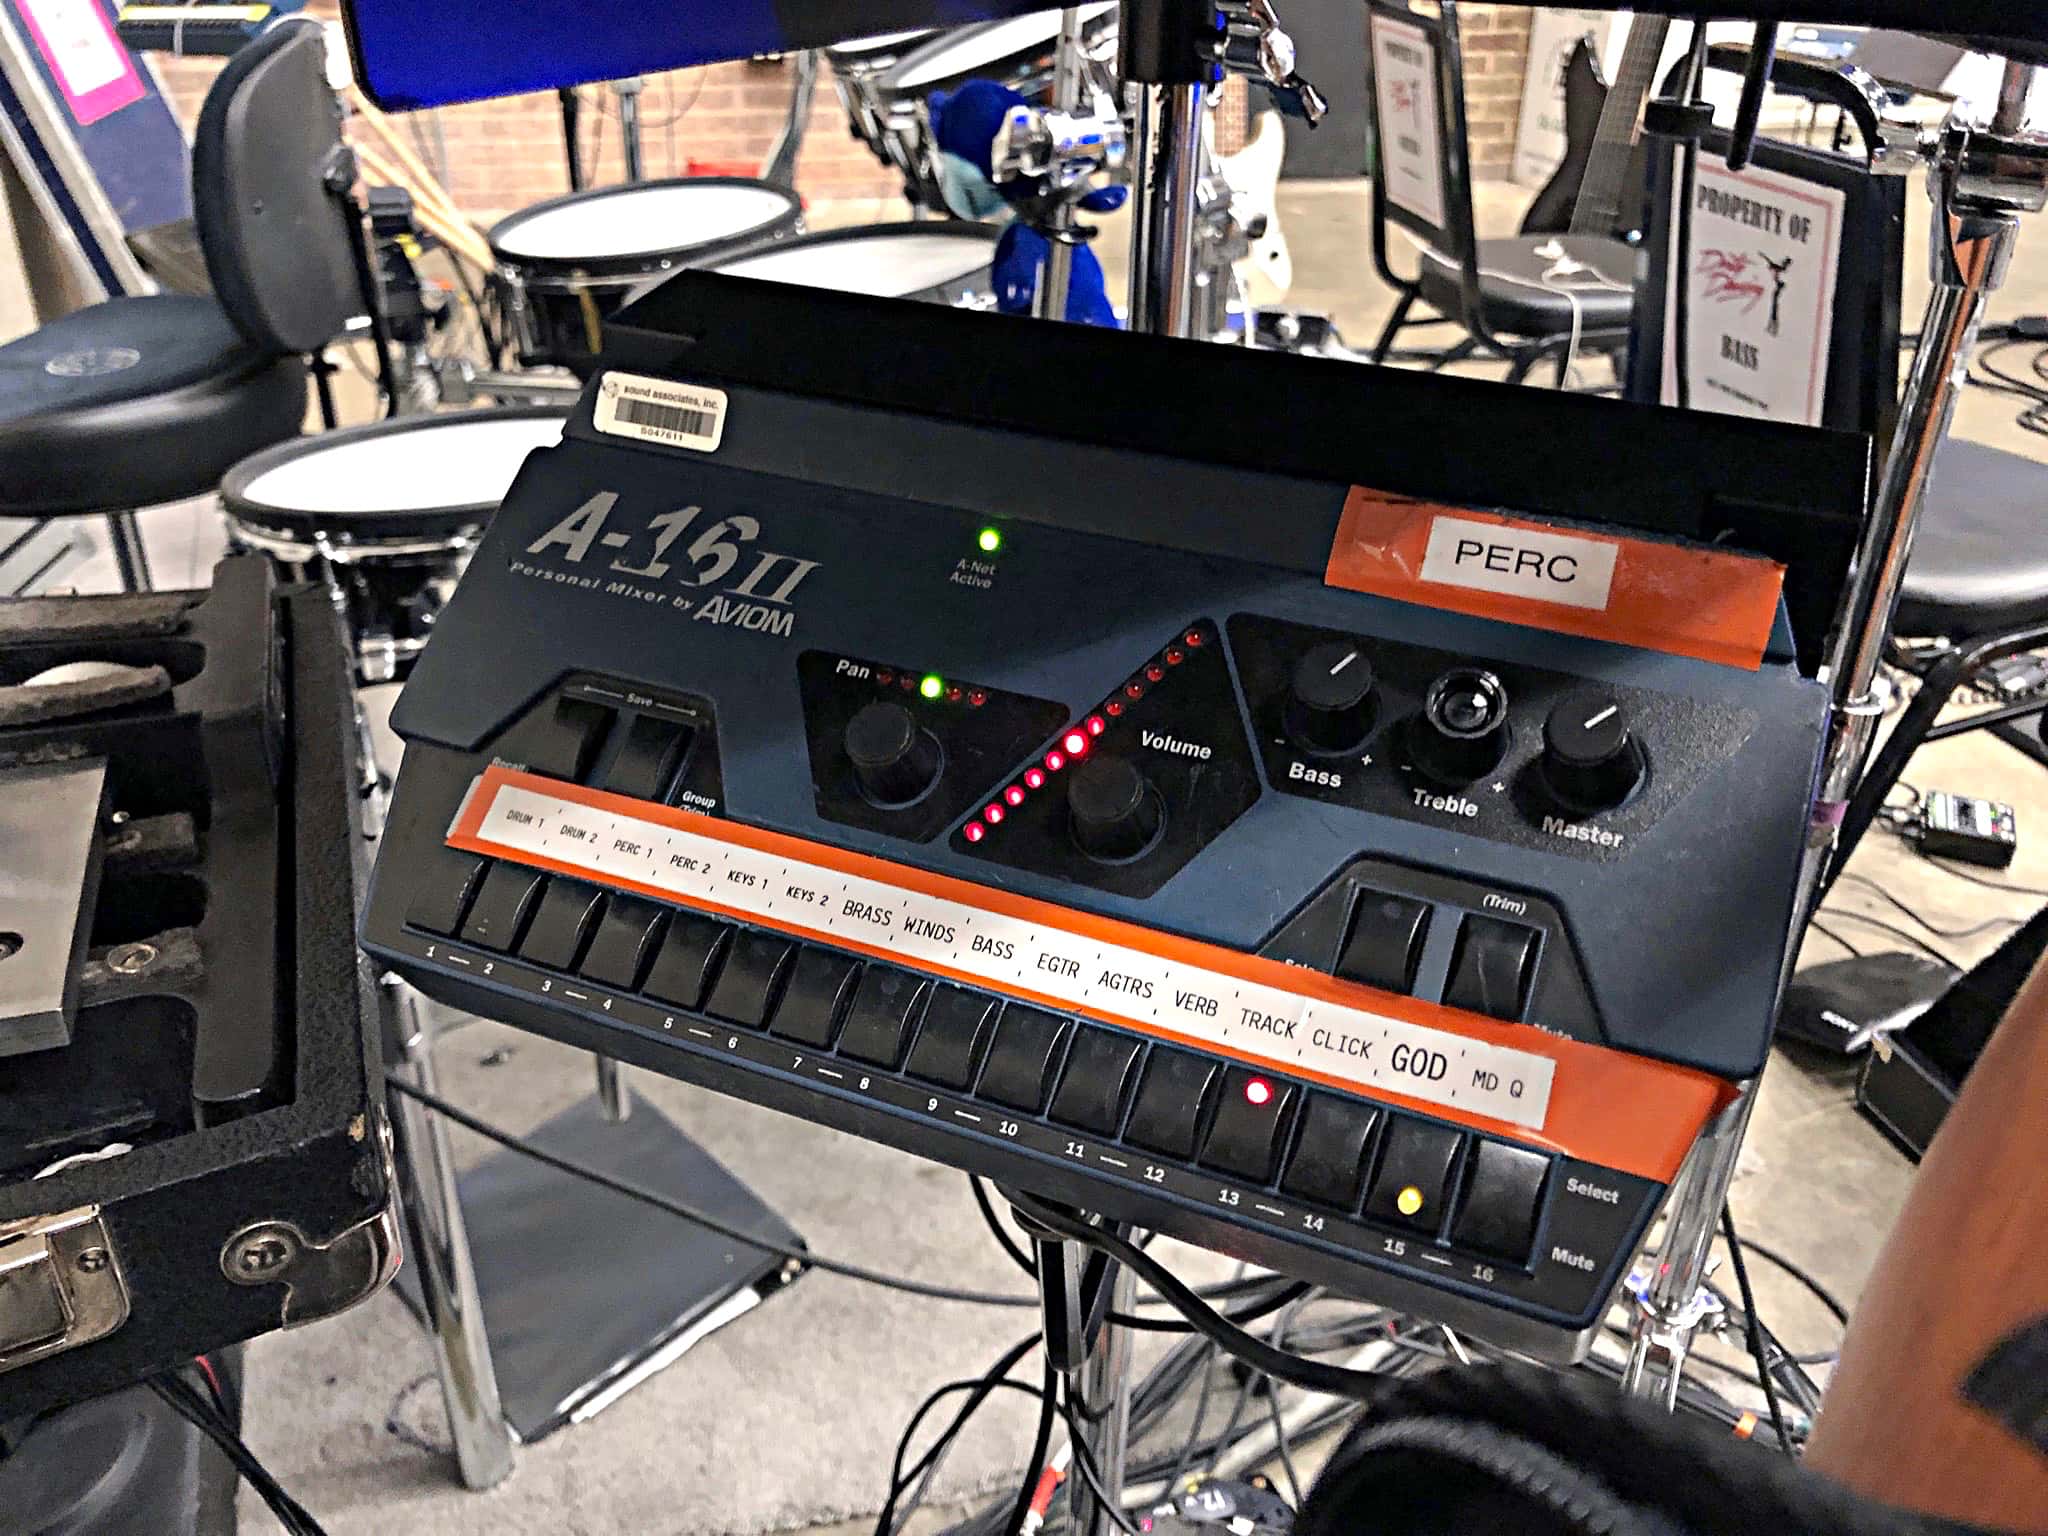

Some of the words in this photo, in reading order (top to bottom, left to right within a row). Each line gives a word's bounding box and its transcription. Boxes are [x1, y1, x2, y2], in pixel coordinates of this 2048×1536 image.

[1696, 184, 1783, 235] PROPERTY
[1789, 214, 1811, 244] OF
[1721, 333, 1759, 371] BASS
[956, 558, 996, 575] A-Net
[1454, 539, 1579, 583] PERC
[949, 571, 993, 588] Active
[510, 561, 600, 589] Personal
[606, 582, 667, 602] Mixer
[672, 596, 694, 610] by
[692, 595, 795, 637] AVIOM
[835, 659, 871, 680] Pan
[626, 692, 653, 707] Save
[1141, 729, 1213, 760] Volume
[1288, 761, 1343, 788] Bass
[682, 790, 716, 809] Group
[1413, 788, 1479, 818] Treble
[1541, 815, 1626, 849] Master
[1482, 893, 1527, 916] (Trim)
[506, 809, 534, 825] DRUM
[538, 818, 545, 829] 1
[559, 824, 587, 840] DRUM
[589, 833, 599, 844] 2
[613, 839, 641, 856] PERC
[647, 848, 653, 860] 1
[669, 854, 698, 871] PERC
[702, 863, 712, 874] 2
[727, 869, 756, 887] KEYS
[762, 879, 769, 890] 1
[786, 885, 815, 903] KEYS
[820, 895, 830, 906] 2
[842, 899, 893, 927] BRASS
[903, 916, 956, 944] WINDS
[971, 934, 1015, 960] BASS
[1037, 952, 1081, 979] EGTR
[1097, 970, 1154, 999] AGTRS
[1174, 989, 1219, 1017] VERB
[1240, 1007, 1299, 1040] TRACK
[1311, 1028, 1373, 1060] CLICK
[1390, 1043, 1448, 1082] GOD
[1471, 1069, 1499, 1092] MD
[1509, 1079, 1525, 1099] Q
[426, 945, 436, 958] 1
[483, 963, 494, 975] 2
[541, 980, 552, 992] 3
[602, 998, 613, 1011] 4
[663, 1017, 673, 1030] 5
[727, 1037, 739, 1050] 6
[793, 1056, 803, 1069] 7
[859, 1077, 870, 1091] 8
[927, 1098, 939, 1112] 9
[999, 1120, 1019, 1137] 10
[1065, 1141, 1085, 1158] 11
[1143, 1166, 1165, 1183] 12
[1218, 1188, 1241, 1206] 13
[1303, 1214, 1325, 1233] 14
[1383, 1238, 1406, 1257] 15
[1471, 1264, 1495, 1283] 16
[1566, 1177, 1620, 1205] Select
[1551, 1246, 1596, 1273] Mute
